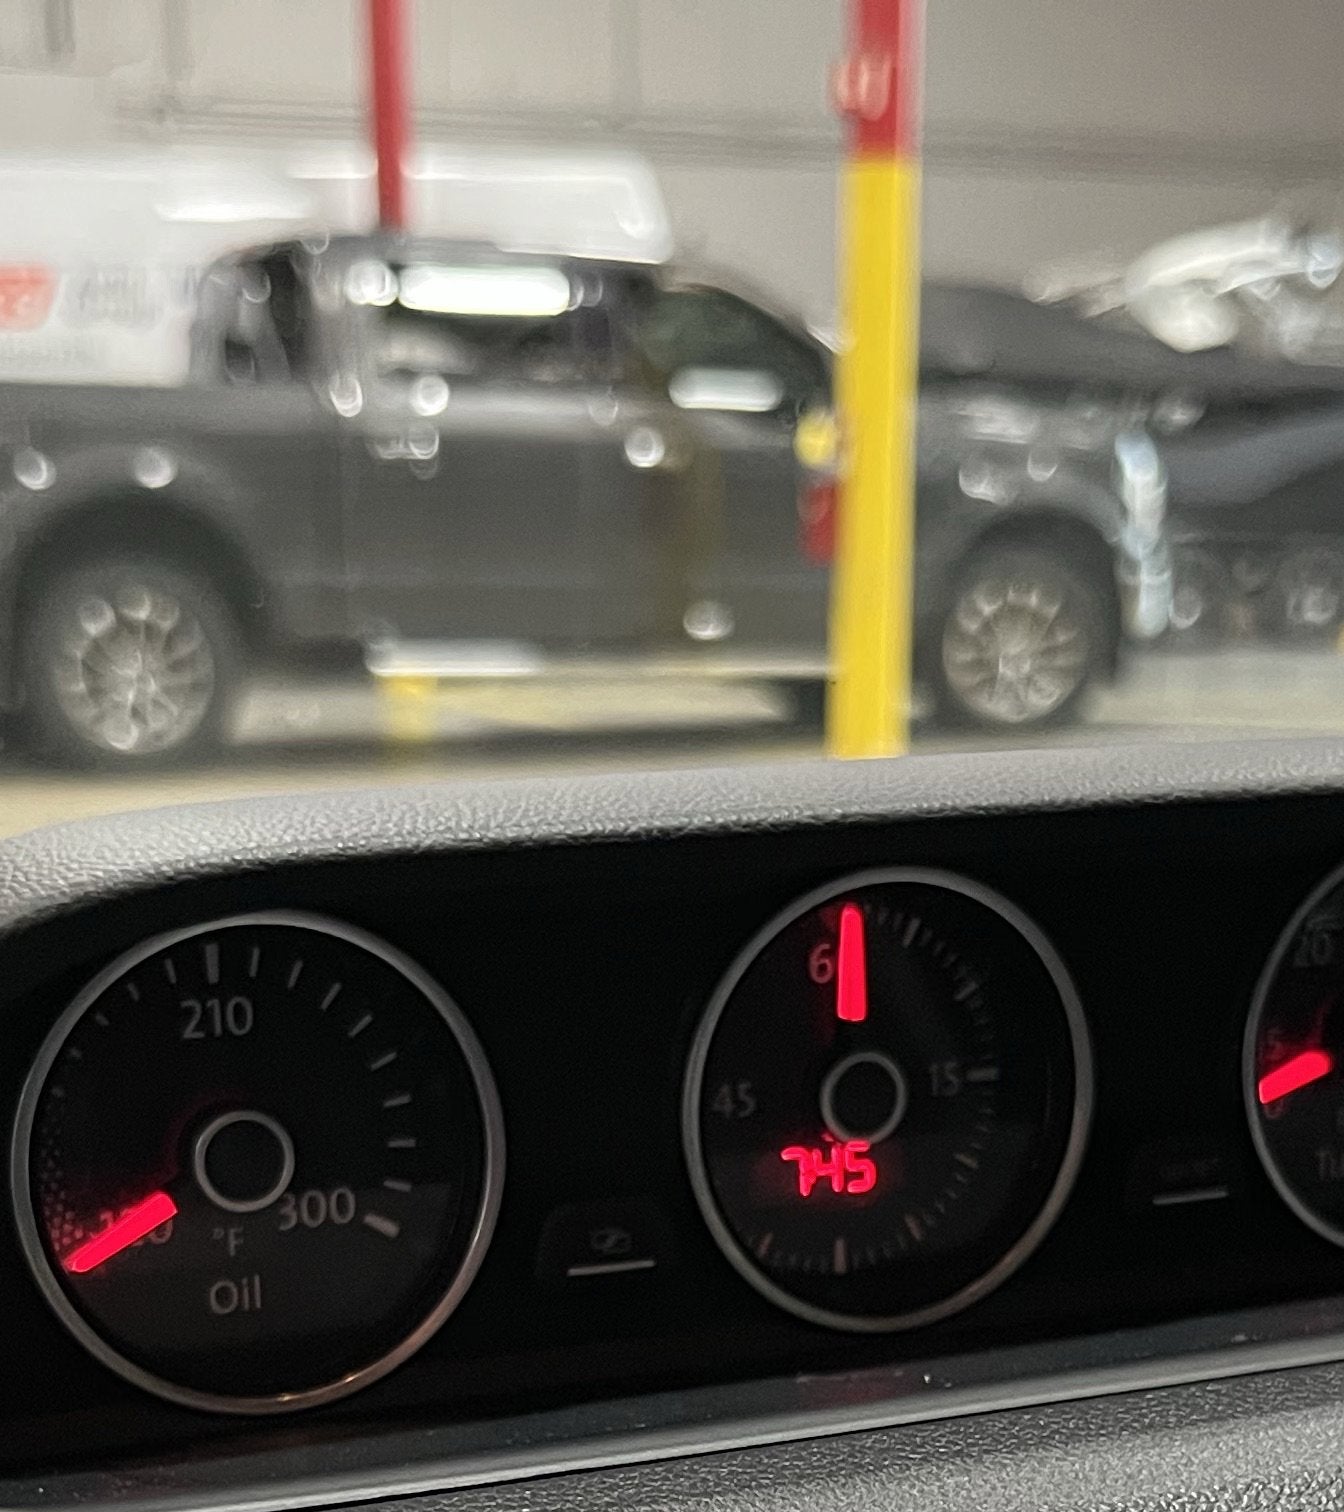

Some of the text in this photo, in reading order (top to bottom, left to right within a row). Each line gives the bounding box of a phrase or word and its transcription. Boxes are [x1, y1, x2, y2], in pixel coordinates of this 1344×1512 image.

[180, 997, 255, 1040] 210
[278, 1186, 357, 1232] 300
[208, 1275, 262, 1315] Oil
